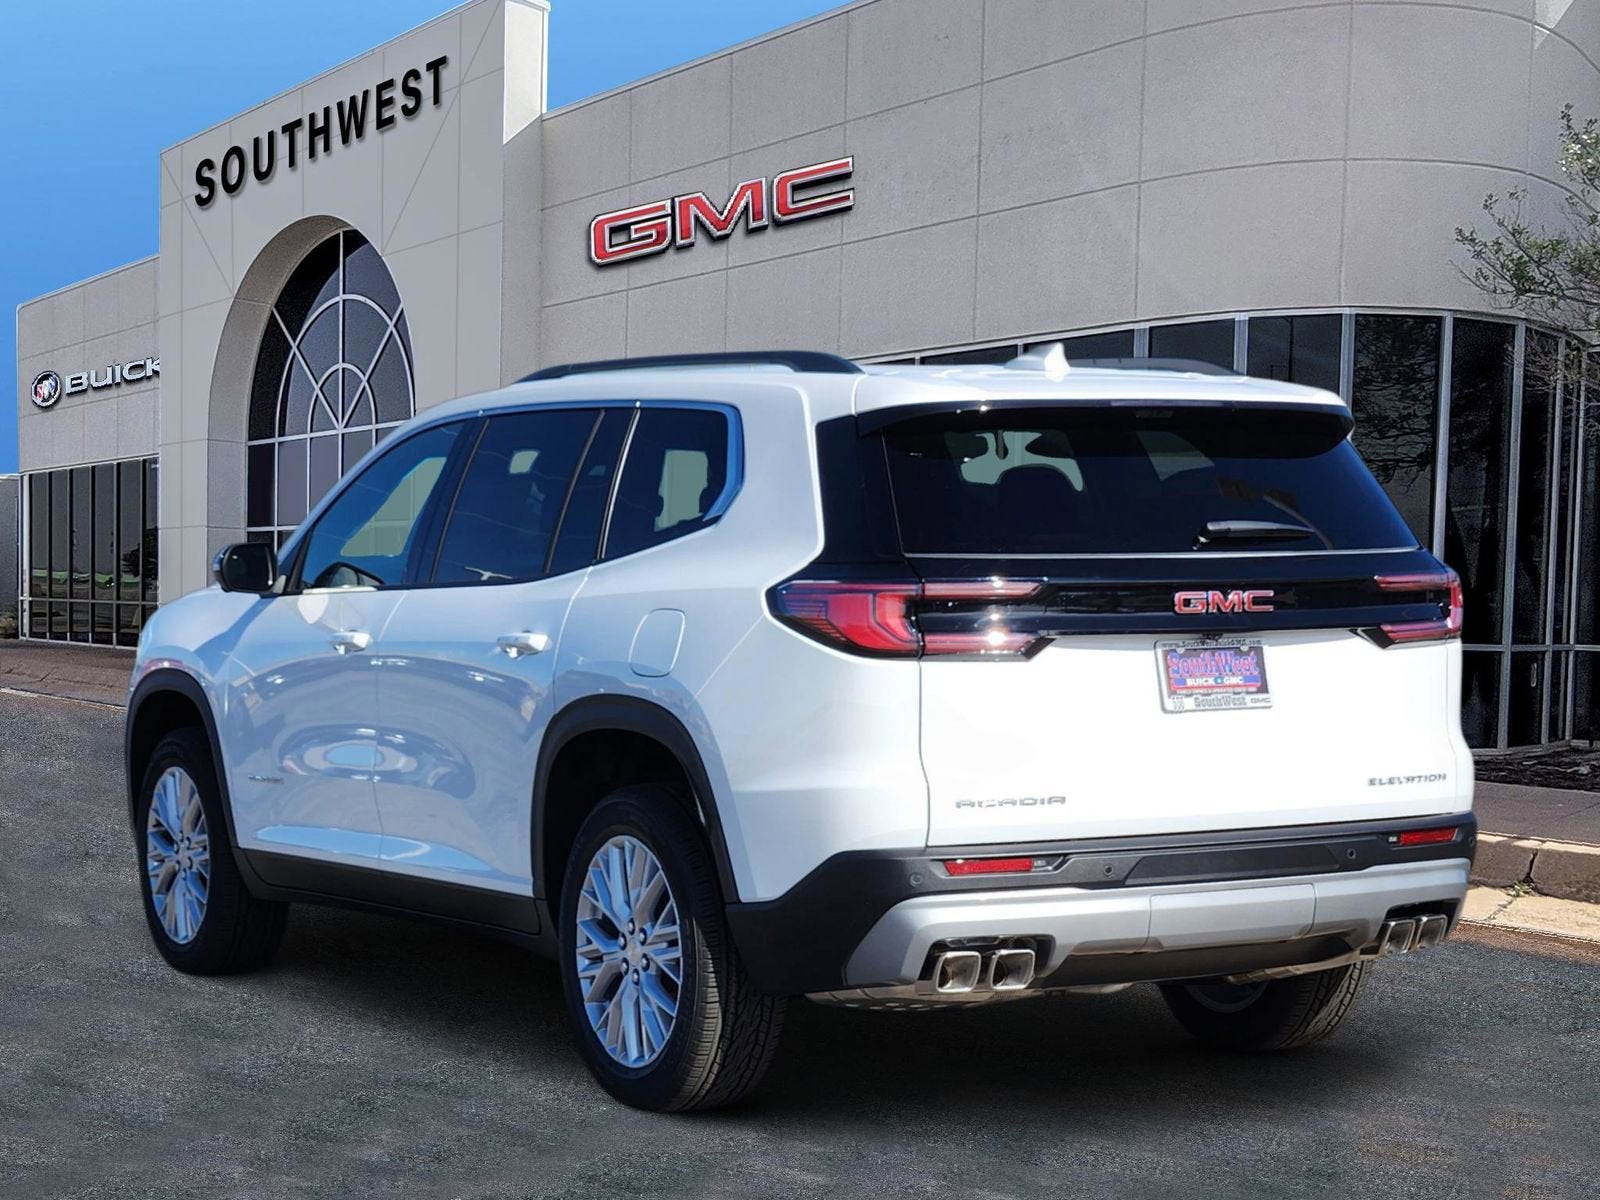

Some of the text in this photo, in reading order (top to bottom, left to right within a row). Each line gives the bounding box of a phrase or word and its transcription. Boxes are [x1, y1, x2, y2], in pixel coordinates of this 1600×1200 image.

[194, 55, 448, 207] SOUTHWEST
[579, 155, 855, 268] GMC
[1174, 589, 1274, 614] GMC
[1185, 675, 1244, 686] BUICK GMC
[1193, 694, 1247, 707] SouthWest
[1368, 773, 1447, 786] ELEVATION
[955, 796, 1066, 809] ACADIA
